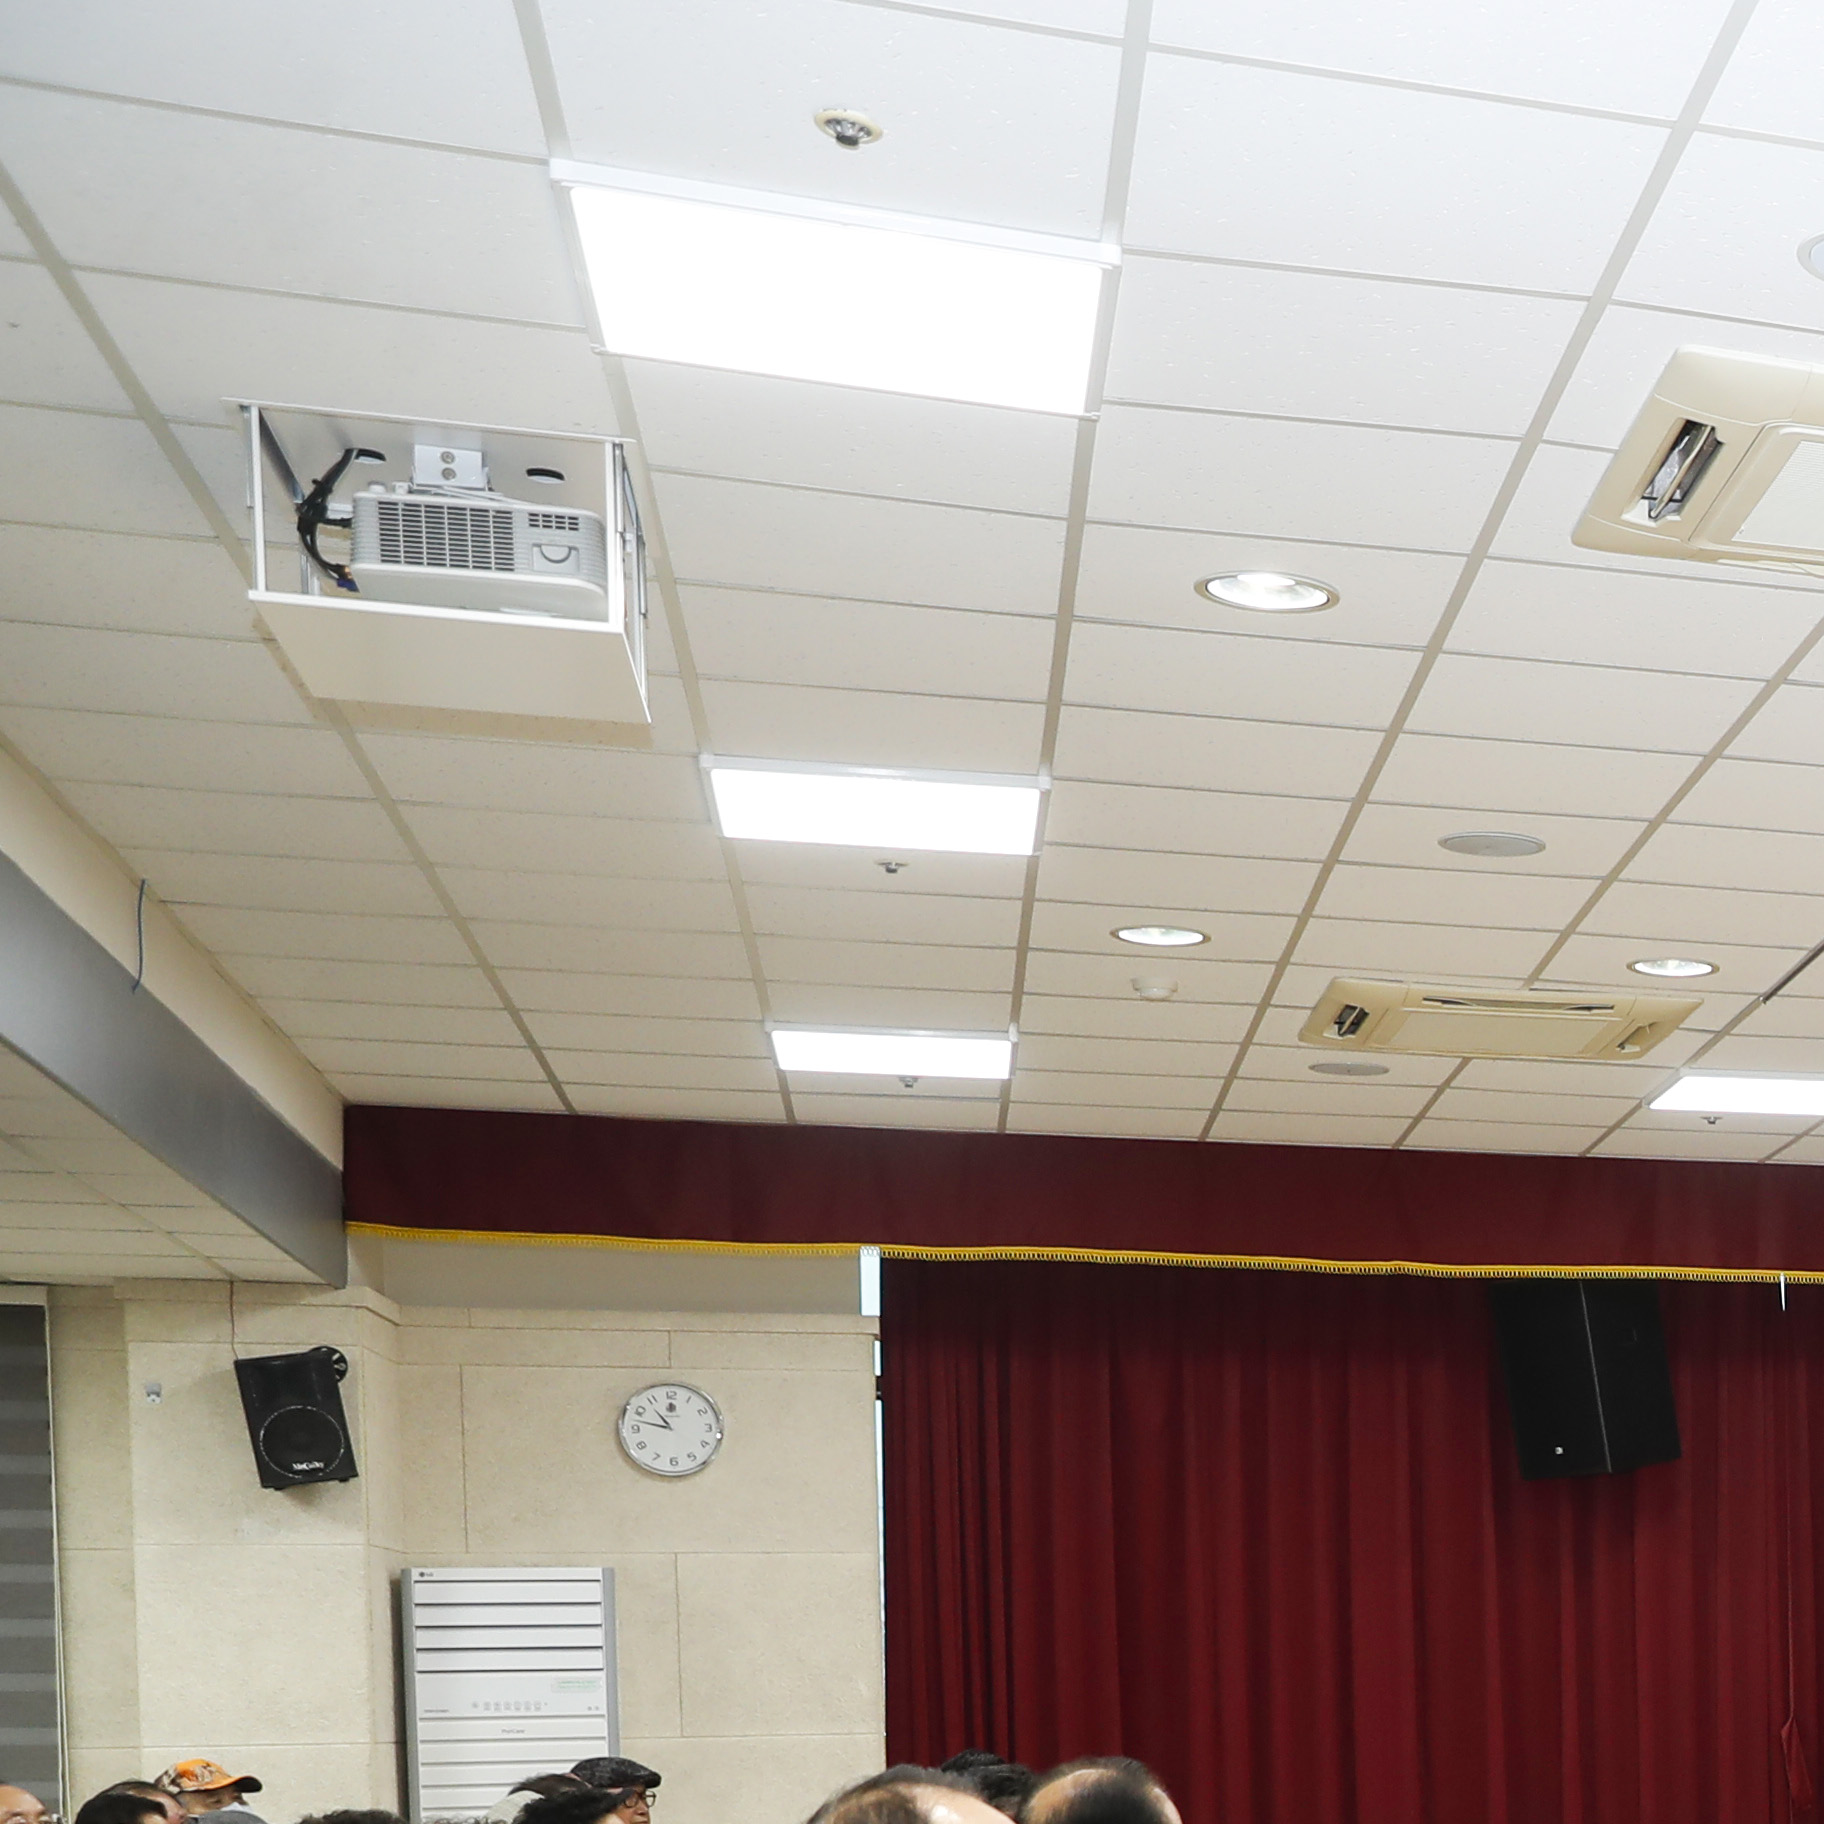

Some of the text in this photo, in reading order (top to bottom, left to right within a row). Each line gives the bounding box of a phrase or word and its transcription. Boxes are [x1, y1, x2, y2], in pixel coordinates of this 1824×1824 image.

[666, 1391, 677, 1400] 12
[697, 1407, 708, 1416] 2
[631, 1424, 640, 1434] 9
[704, 1423, 712, 1433] 3
[669, 1457, 679, 1466] 6
